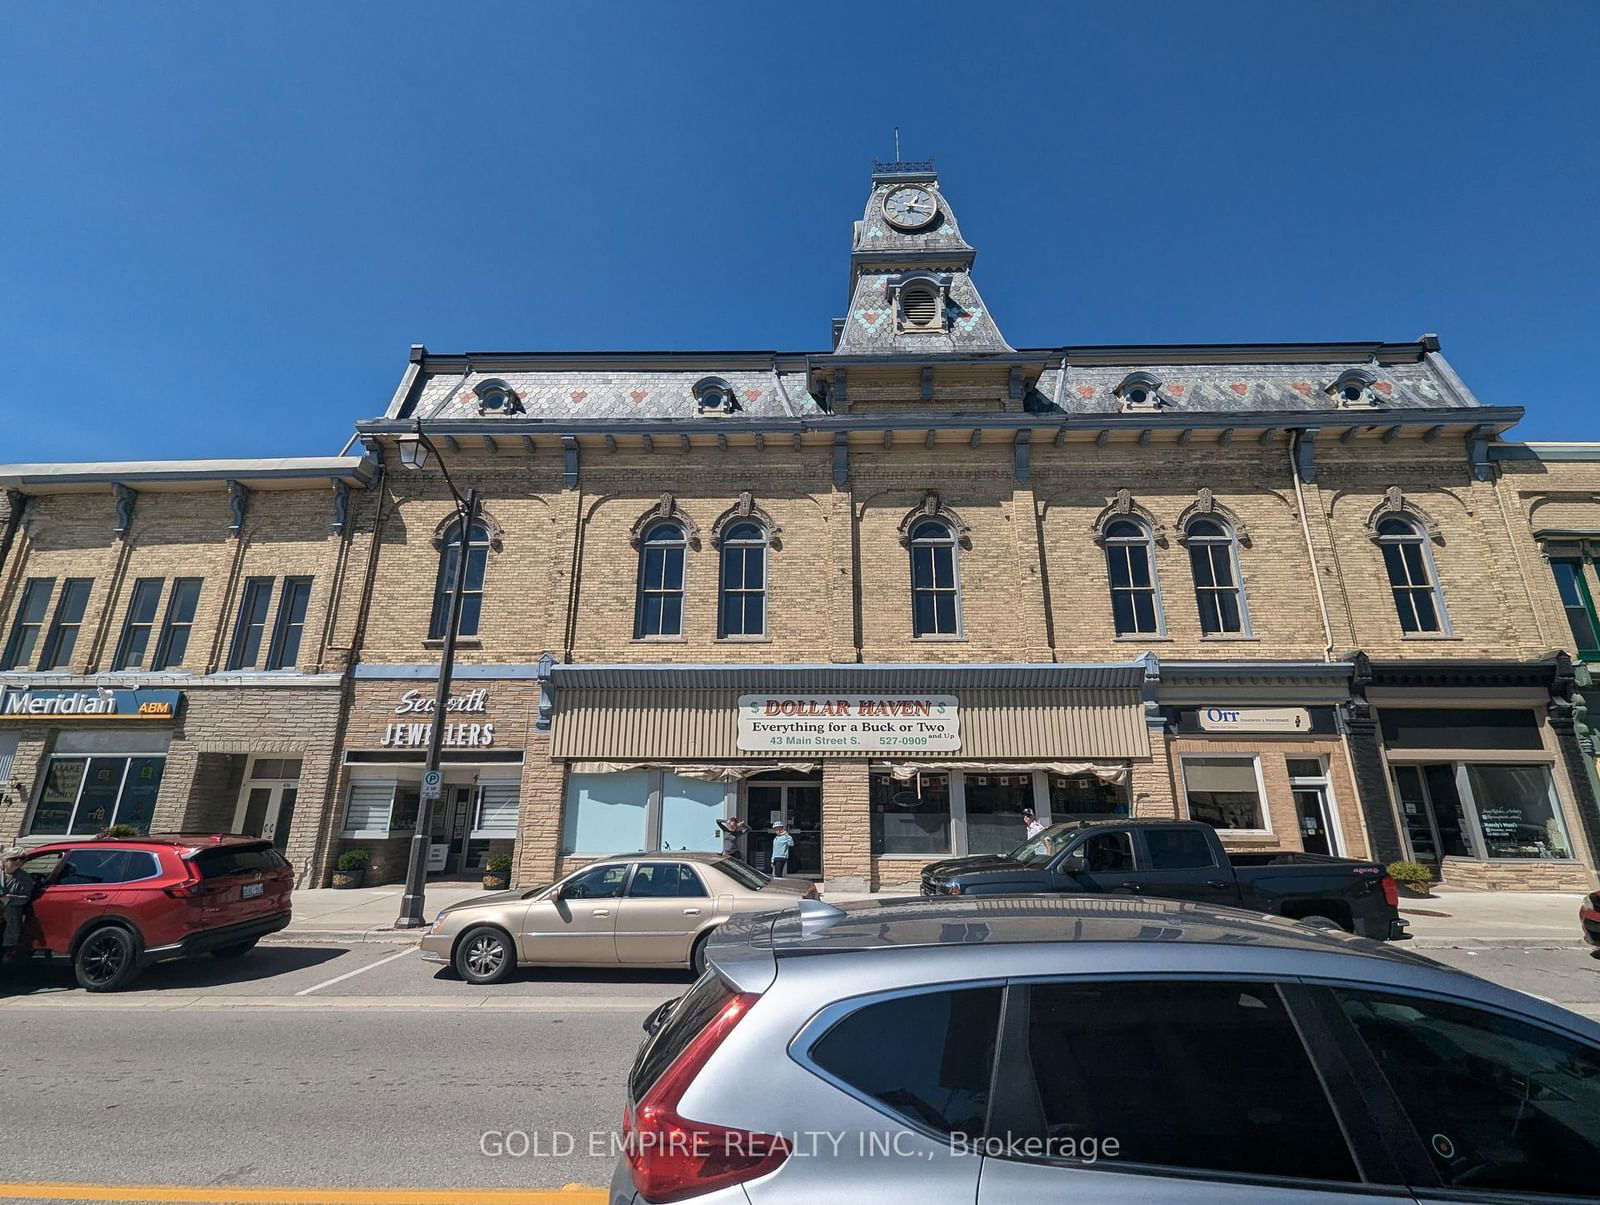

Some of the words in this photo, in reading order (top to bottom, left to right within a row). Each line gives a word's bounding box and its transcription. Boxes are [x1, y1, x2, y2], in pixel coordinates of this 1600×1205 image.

[4, 692, 117, 715] Meridian
[138, 702, 171, 713] ABM
[394, 688, 487, 714] Seaorth
[750, 701, 760, 714] $
[764, 699, 851, 717] DOLLAR
[857, 699, 932, 717] HAVEN
[937, 702, 946, 714] $
[1207, 708, 1240, 723] Orr
[380, 723, 494, 746] JEWELERS
[752, 722, 825, 734] Everything
[828, 722, 847, 732] for
[850, 724, 858, 732] a
[861, 722, 896, 732] Buck
[899, 724, 914, 732] or
[916, 722, 945, 732] Two
[770, 736, 783, 745] 43
[786, 736, 812, 745] Main
[815, 736, 847, 745] Street
[850, 736, 861, 745] S.
[879, 737, 928, 745] 527-0909
